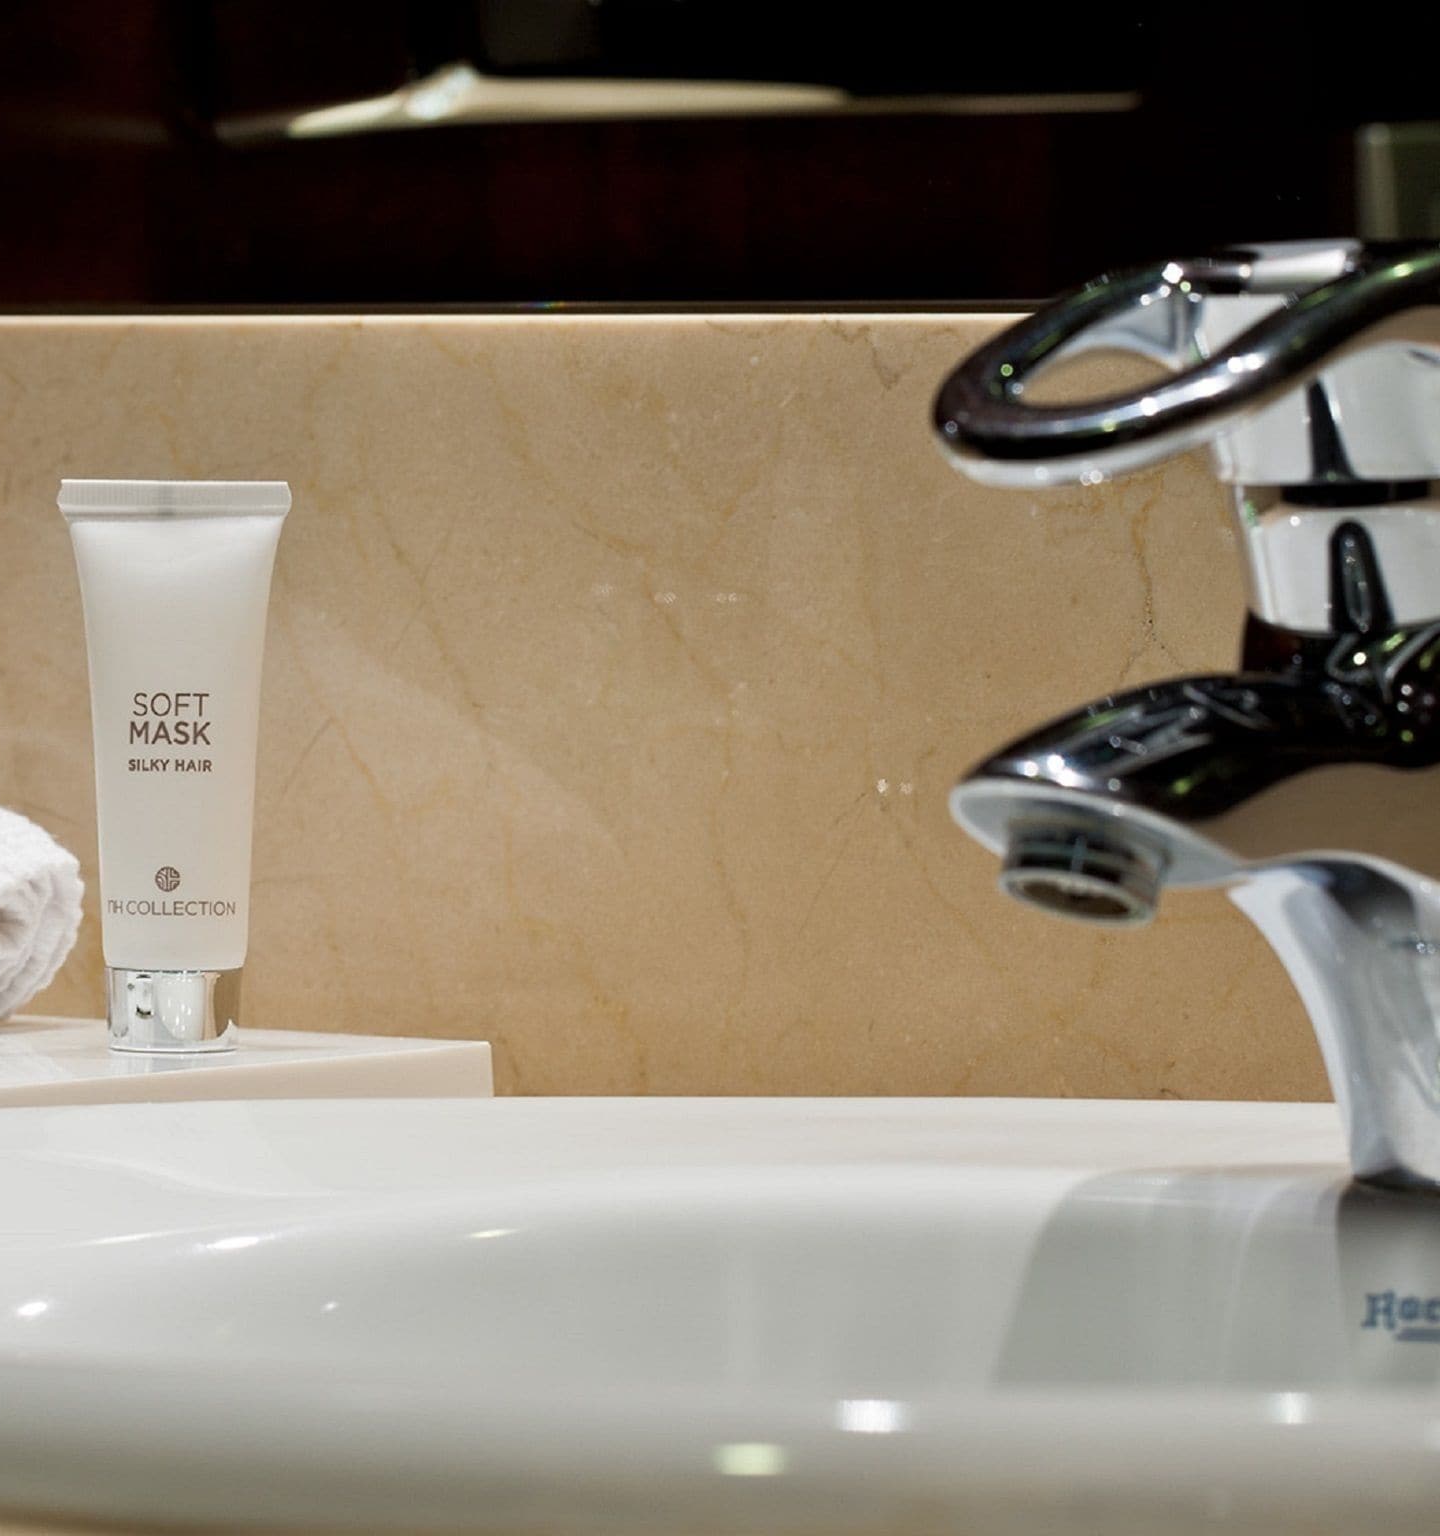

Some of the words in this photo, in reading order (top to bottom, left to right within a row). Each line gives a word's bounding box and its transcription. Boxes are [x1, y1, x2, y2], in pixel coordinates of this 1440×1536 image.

[132, 692, 210, 717] SOFT
[129, 721, 211, 745] MASK
[128, 759, 170, 772] SILKY
[175, 759, 212, 772] HAIR
[126, 901, 236, 916] COLLECTION
